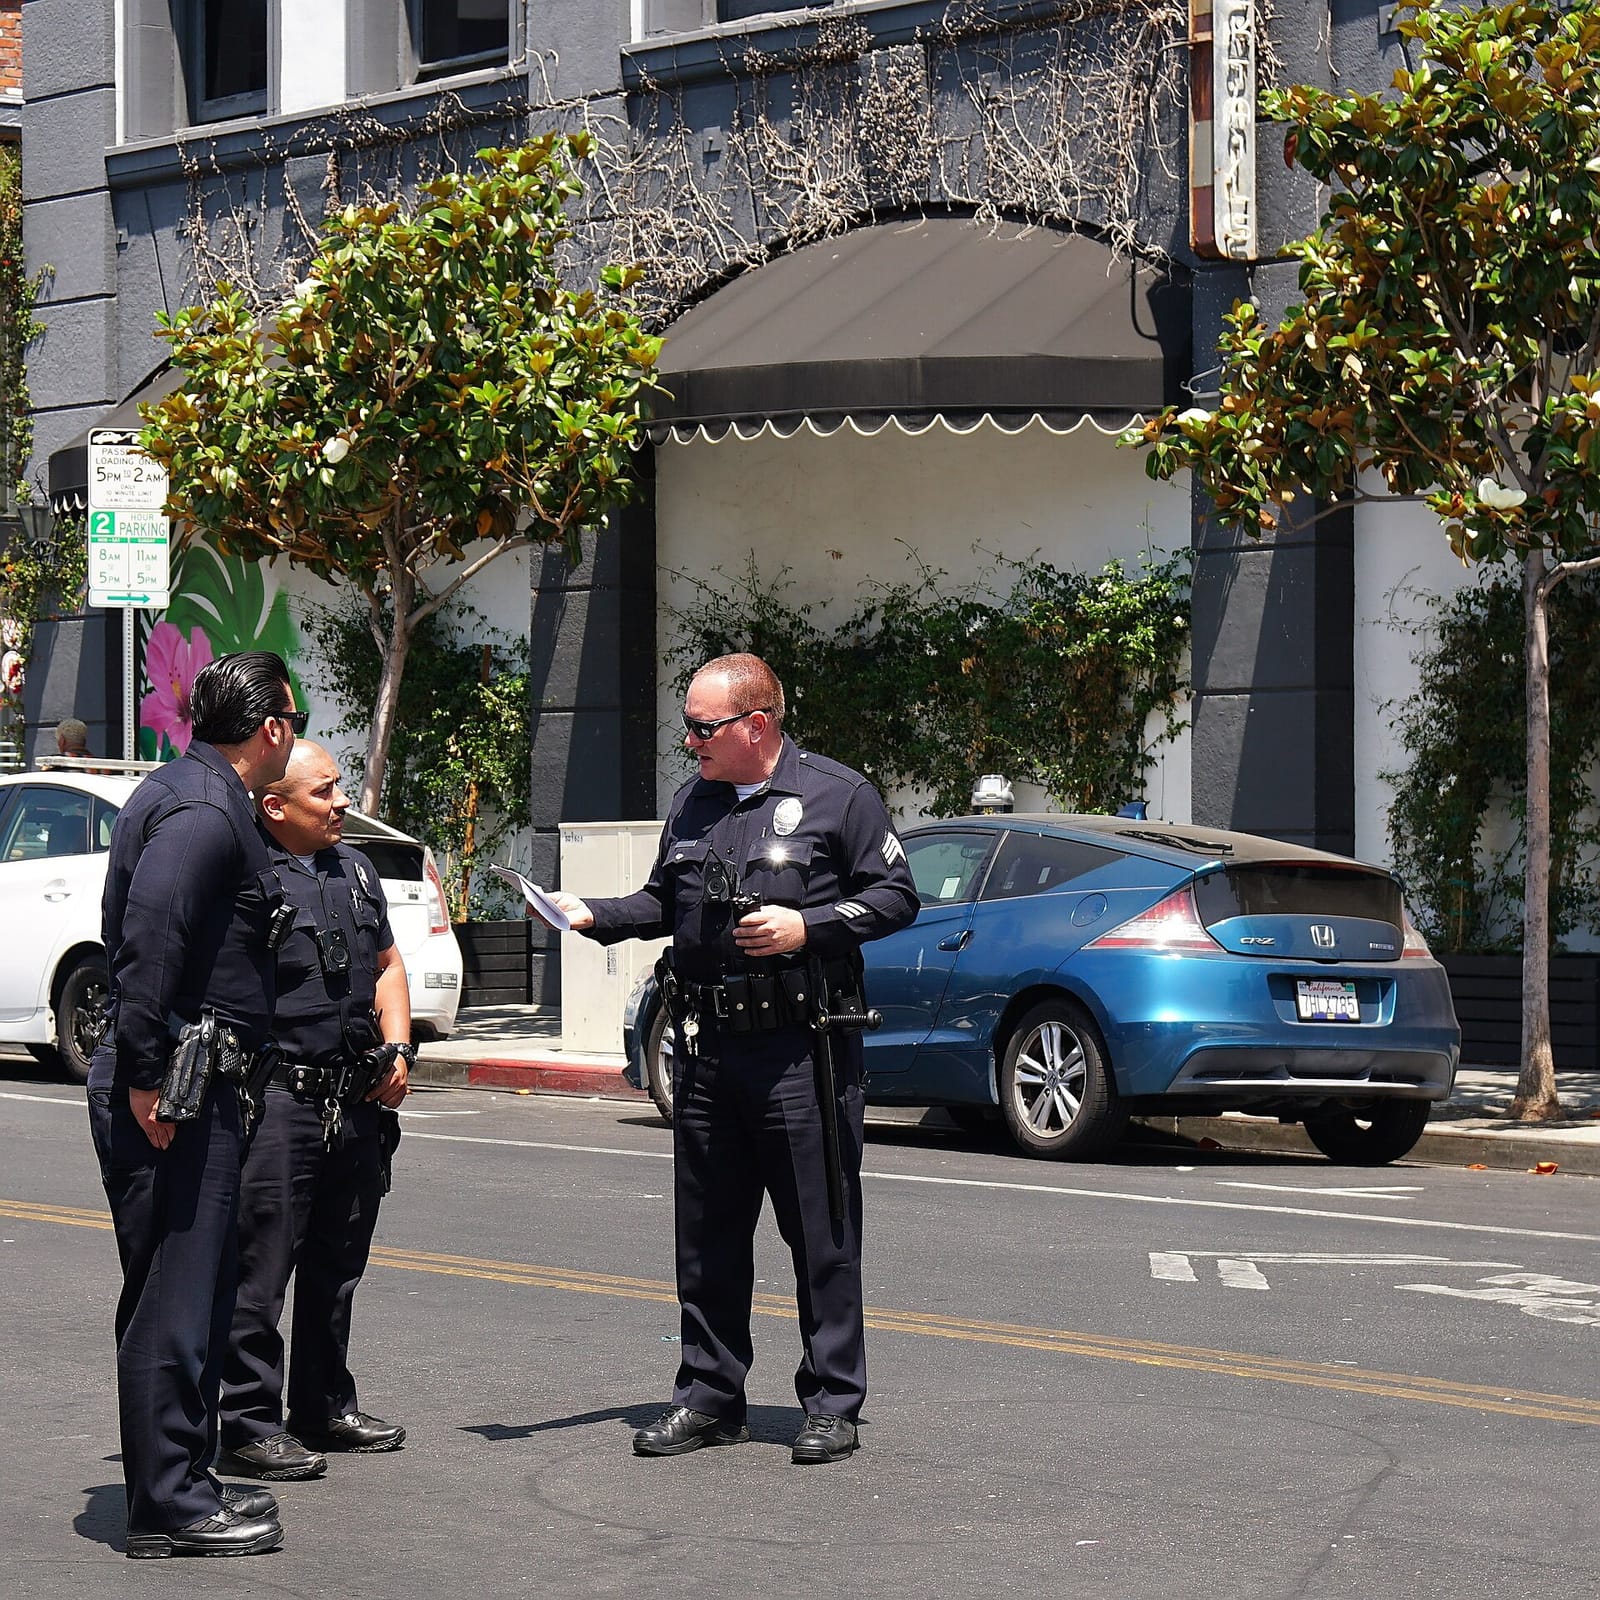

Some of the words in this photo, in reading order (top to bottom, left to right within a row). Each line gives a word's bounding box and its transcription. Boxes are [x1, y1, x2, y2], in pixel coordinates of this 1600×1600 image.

[97, 467, 121, 482] 5PM
[123, 470, 131, 478] TO
[95, 513, 110, 533] 2
[119, 522, 166, 537] PARKING
[99, 571, 120, 584] 5PM
[137, 572, 157, 585] 5PM
[1308, 982, 1342, 995] California
